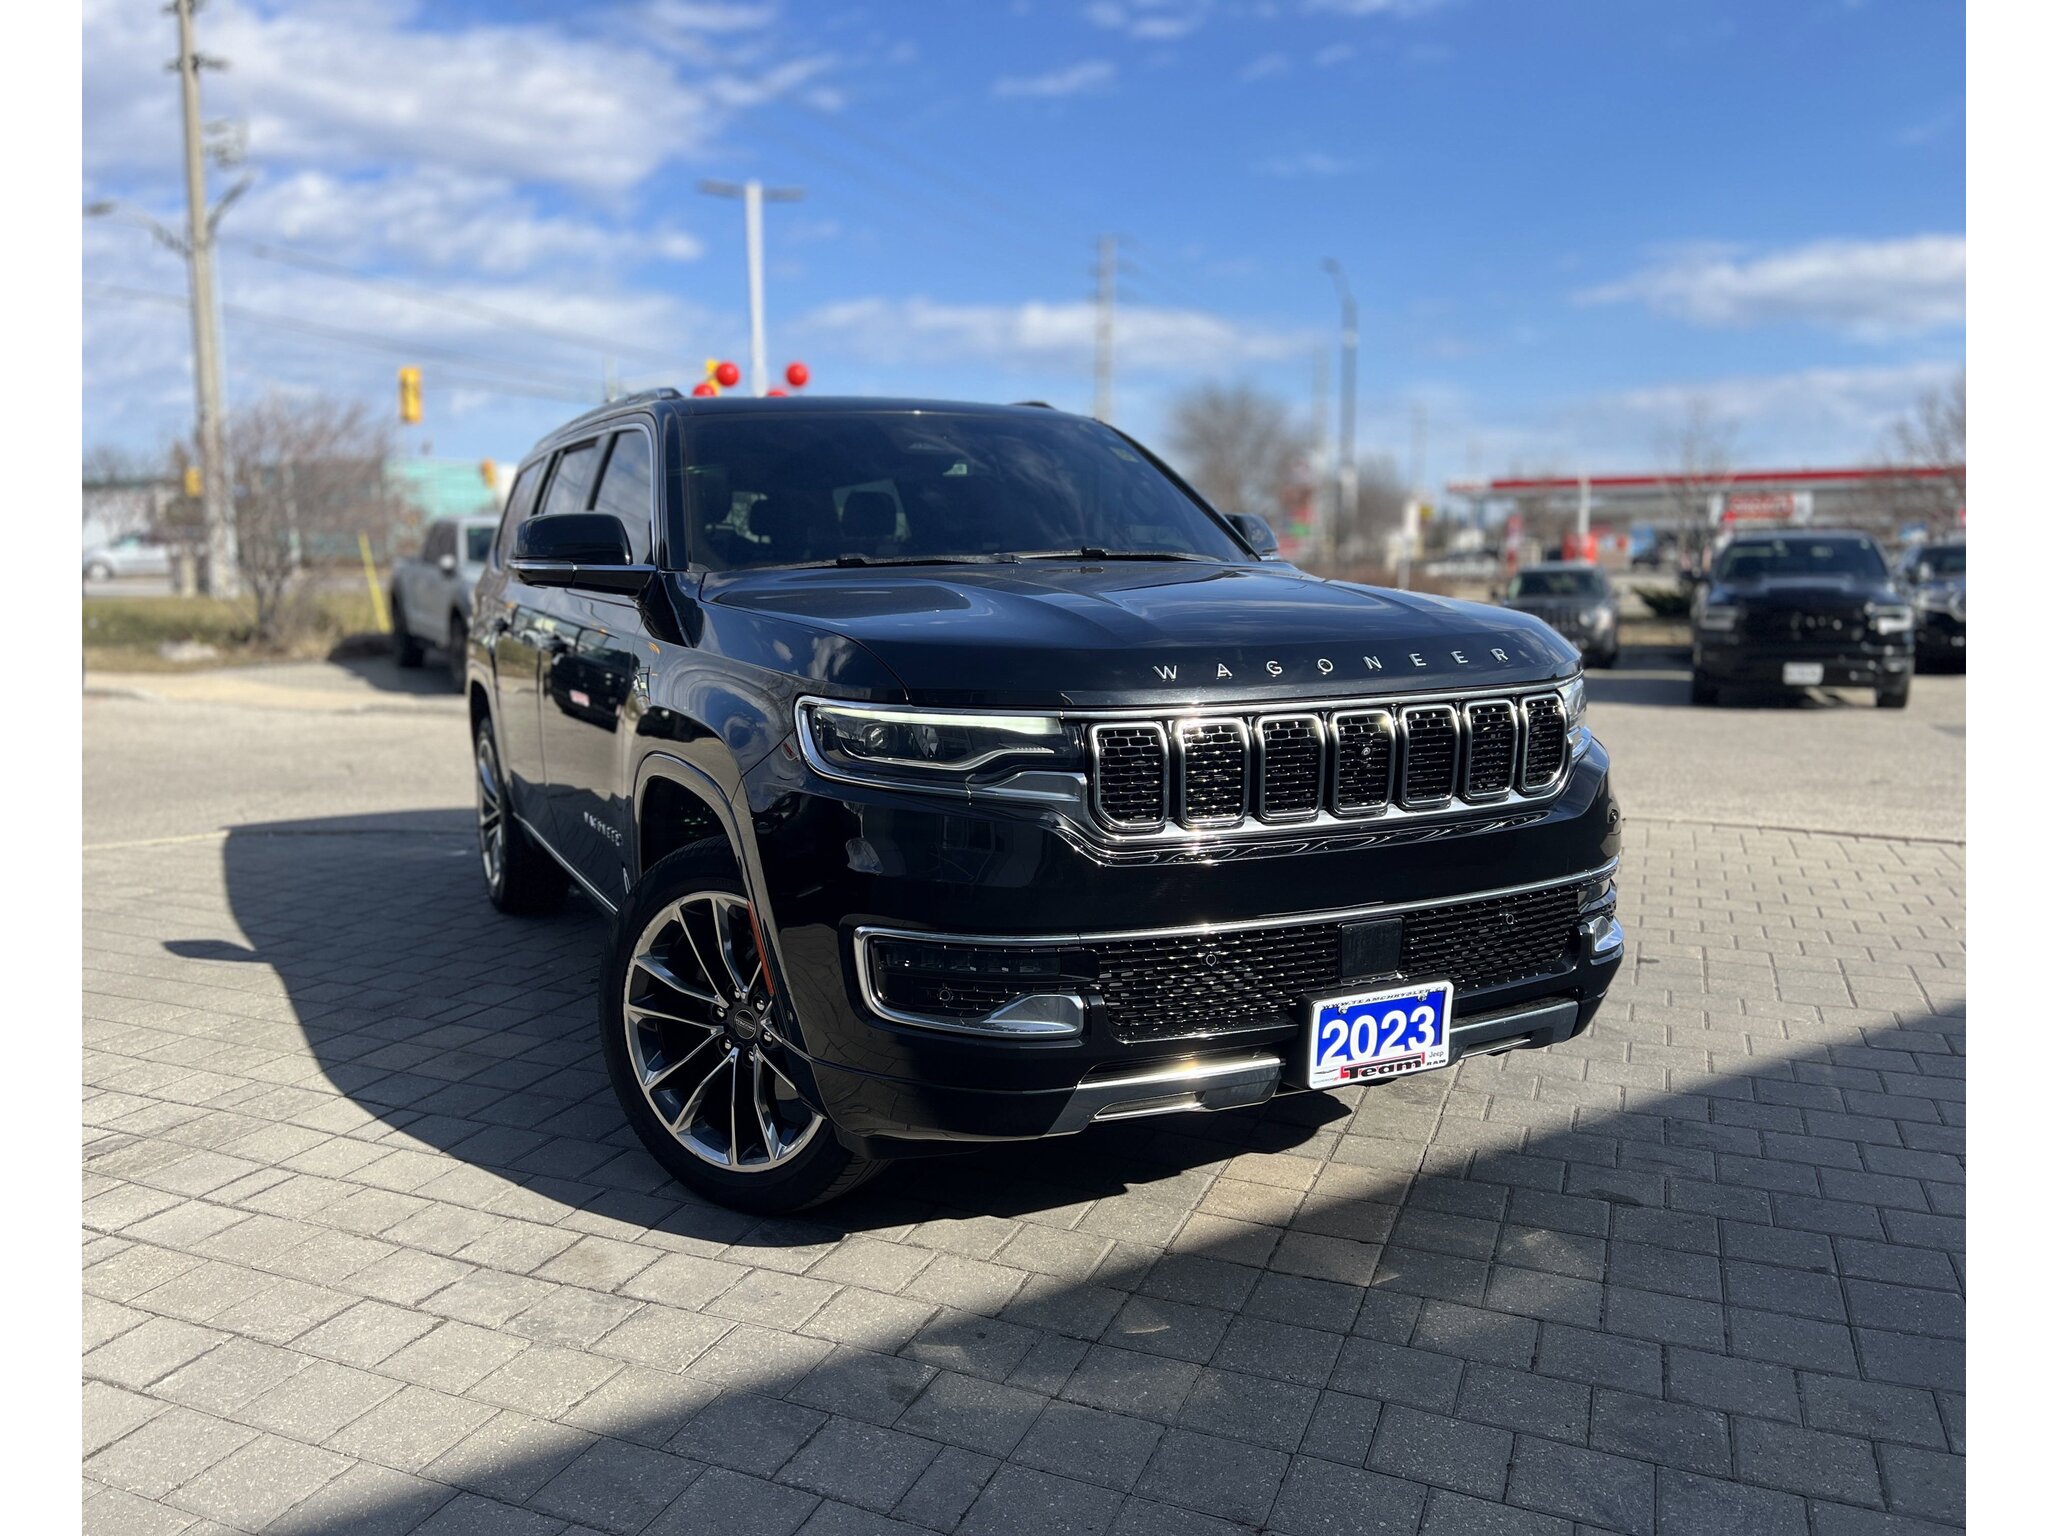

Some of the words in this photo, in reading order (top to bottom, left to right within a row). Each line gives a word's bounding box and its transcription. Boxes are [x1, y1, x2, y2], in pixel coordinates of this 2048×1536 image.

[1152, 648, 1509, 681] WAGONEER
[1320, 1005, 1435, 1067] 2023
[1344, 1055, 1422, 1079] Team
[1428, 1050, 1444, 1058] Jeep
